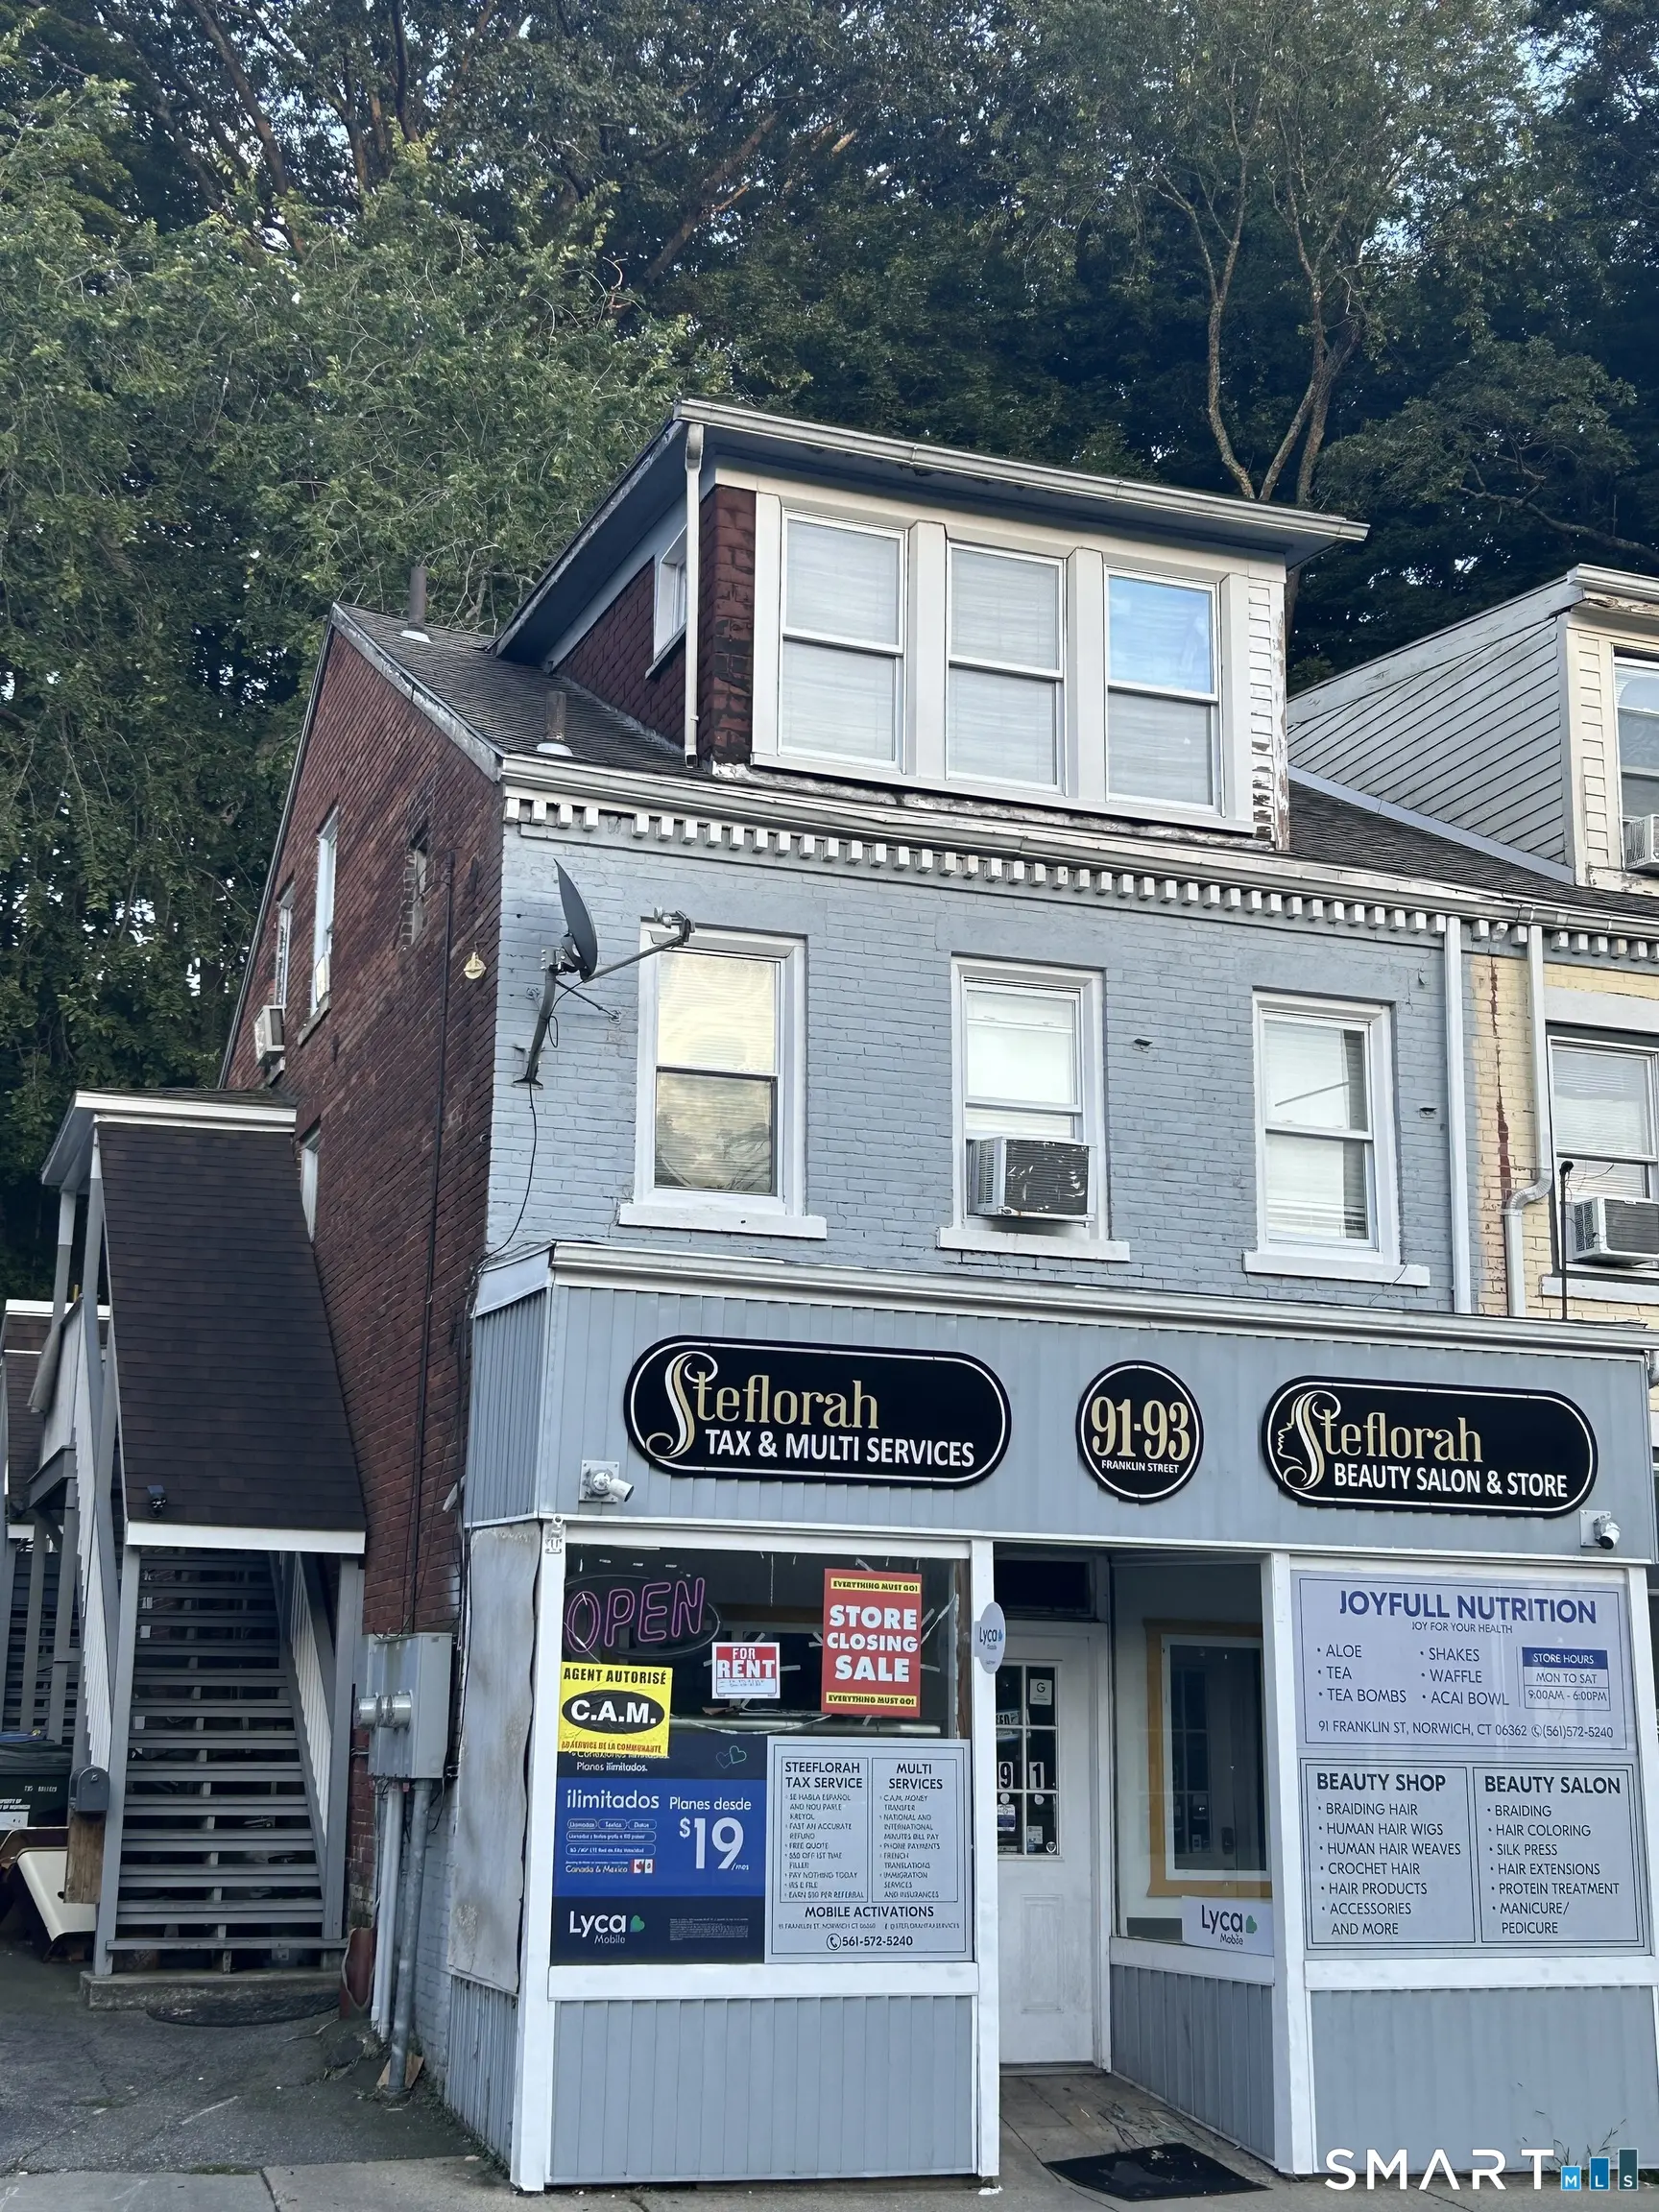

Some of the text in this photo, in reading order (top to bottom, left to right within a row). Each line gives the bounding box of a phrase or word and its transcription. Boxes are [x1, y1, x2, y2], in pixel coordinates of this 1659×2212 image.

[646, 1351, 878, 1458] Steflorah
[1091, 1396, 1190, 1461] 91-93
[1284, 1390, 1482, 1490] Steflorah
[706, 1429, 974, 1467] TAX & MULTI SERVICES
[1101, 1460, 1179, 1474] FRANKLIN STREET
[1334, 1463, 1568, 1498] BEAUTY SALON & STORE
[832, 1580, 918, 1592] EVERYTHING MUST GO!
[1340, 1590, 1597, 1623] JOYFULL NUTRITION
[566, 1577, 705, 1653] OPEN
[829, 1604, 917, 1630] STORE
[1411, 1622, 1513, 1634] JOY FOR YOUR HEALTH
[827, 1632, 918, 1653] CLOSING
[979, 1626, 998, 1646] Lyca
[733, 1647, 756, 1660] FOR
[1326, 1645, 1362, 1658] ALOE
[1429, 1647, 1480, 1662] SHAKES
[1533, 1652, 1594, 1665] STORE HOURS
[717, 1659, 775, 1678] RENT
[835, 1655, 909, 1682] SALE
[1326, 1667, 1352, 1680] TEA
[564, 1668, 666, 1685] AGENT AUTORISÉ
[1430, 1669, 1482, 1684] WAFFLE
[1536, 1672, 1597, 1684] MON TO SAT
[828, 1694, 915, 1706] EVERYTHING MUST GO!
[1327, 1688, 1407, 1703] TEA BOMBS
[1431, 1691, 1510, 1706] ACAI BOWL
[1527, 1689, 1607, 1701] 9:00AM 6:00PM
[570, 1699, 657, 1724] C.A.M.
[1318, 1720, 1613, 1739] 91 FRANKLIN ST, NORWICH, CT 06362 (561)572-5240
[784, 1761, 860, 1773] STEEFLORAH
[897, 1764, 932, 1774] MULTI
[785, 1776, 863, 1789] TAX SERVICE
[1000, 1763, 1042, 1789] 9 1
[1316, 1772, 1446, 1791] BEAUTY SHOP
[888, 1778, 943, 1790] SERVICES
[1485, 1775, 1621, 1794] BEAUTY SALON
[566, 1789, 660, 1809] ilimitados
[669, 1796, 752, 1811] Planes desde
[1326, 1803, 1418, 1815] BRAIDING HAIR
[1495, 1805, 1551, 1817] BRAIDING
[1327, 1823, 1443, 1836] HUMAN HAIR WIGS
[1496, 1824, 1591, 1837] HAIR COLORING
[680, 1816, 744, 1870] $19
[1328, 1842, 1461, 1856] HUMAN HAIR WEAVES
[1497, 1843, 1557, 1856] SILK PRESS
[1328, 1863, 1420, 1875] CROCHET HAIR
[1498, 1863, 1600, 1875] HAIR EXTENSIONS
[1329, 1883, 1428, 1895] HAIR PRODUCTS
[1499, 1883, 1620, 1895] PROTEIN TREATMENT
[805, 1906, 934, 1917] MOBILE ACTIVATIONS
[1330, 1902, 1411, 1914] ACCESSORIES
[1500, 1901, 1570, 1914] MANICURE/
[569, 1911, 627, 1938] Lyca
[1201, 1904, 1242, 1935] Lyca
[1332, 1922, 1399, 1935] AND MORE
[1502, 1922, 1558, 1935] PEDICURE
[593, 1935, 626, 1944] Mobile
[842, 1936, 913, 1947] 561-572-5240
